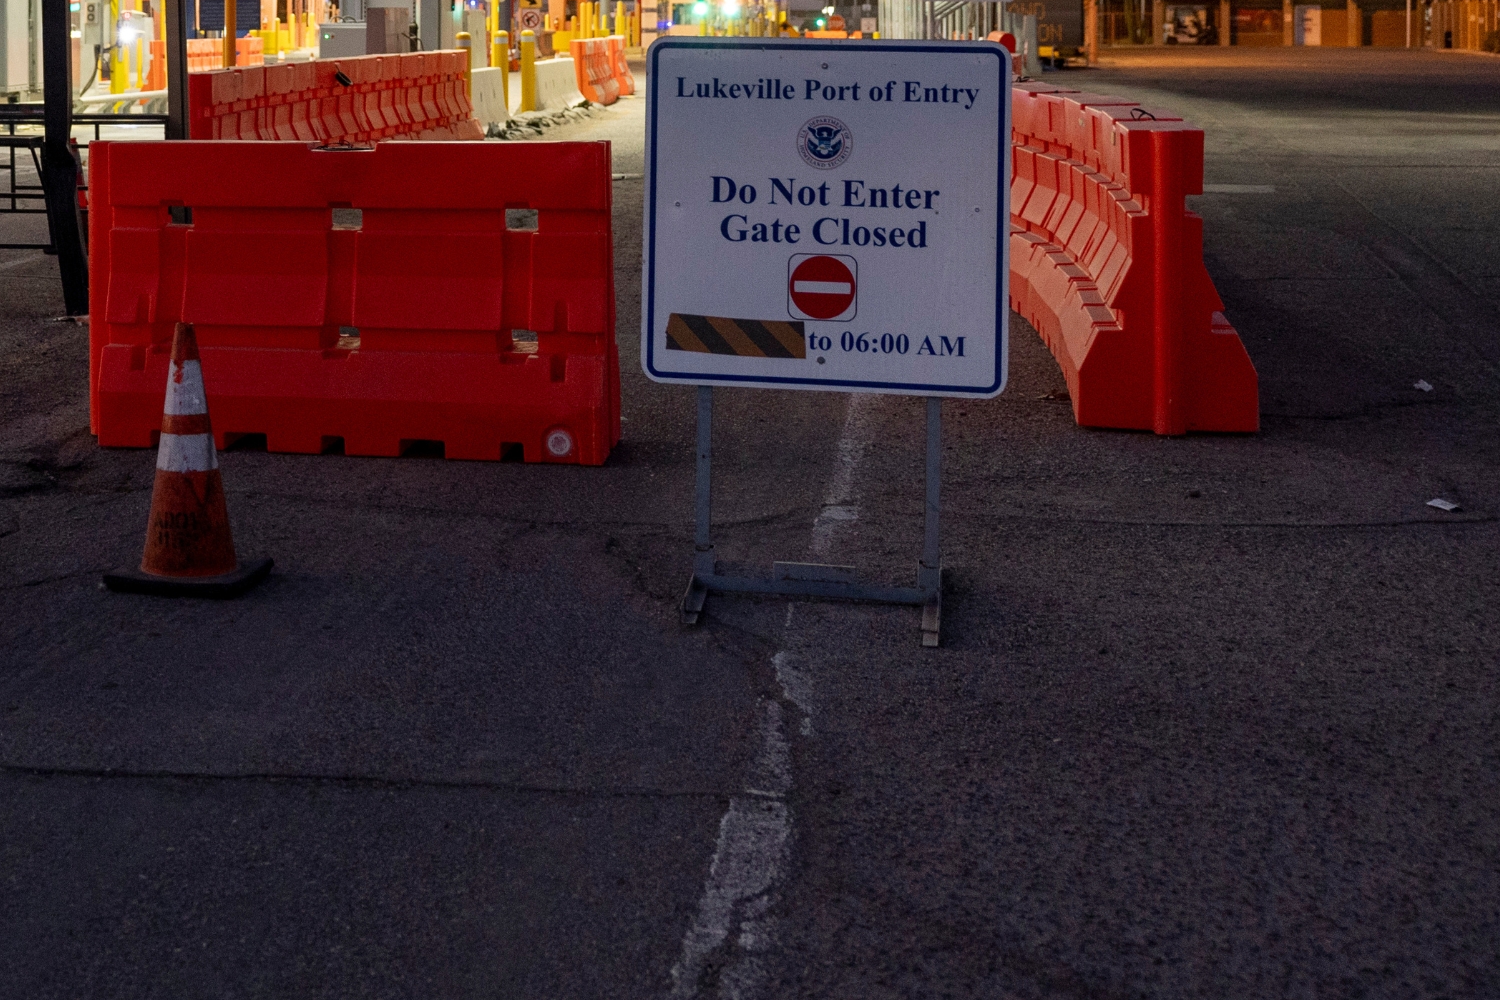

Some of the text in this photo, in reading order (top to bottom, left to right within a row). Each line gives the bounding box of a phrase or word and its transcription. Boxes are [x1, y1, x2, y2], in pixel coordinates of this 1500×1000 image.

[675, 77, 980, 109] Lukeville Port of Entry
[808, 117, 846, 133] DEPARTMENT
[709, 175, 940, 210] Do Not Enter
[720, 214, 928, 248] Gate Closed
[808, 330, 967, 357] to 06:00 AM
